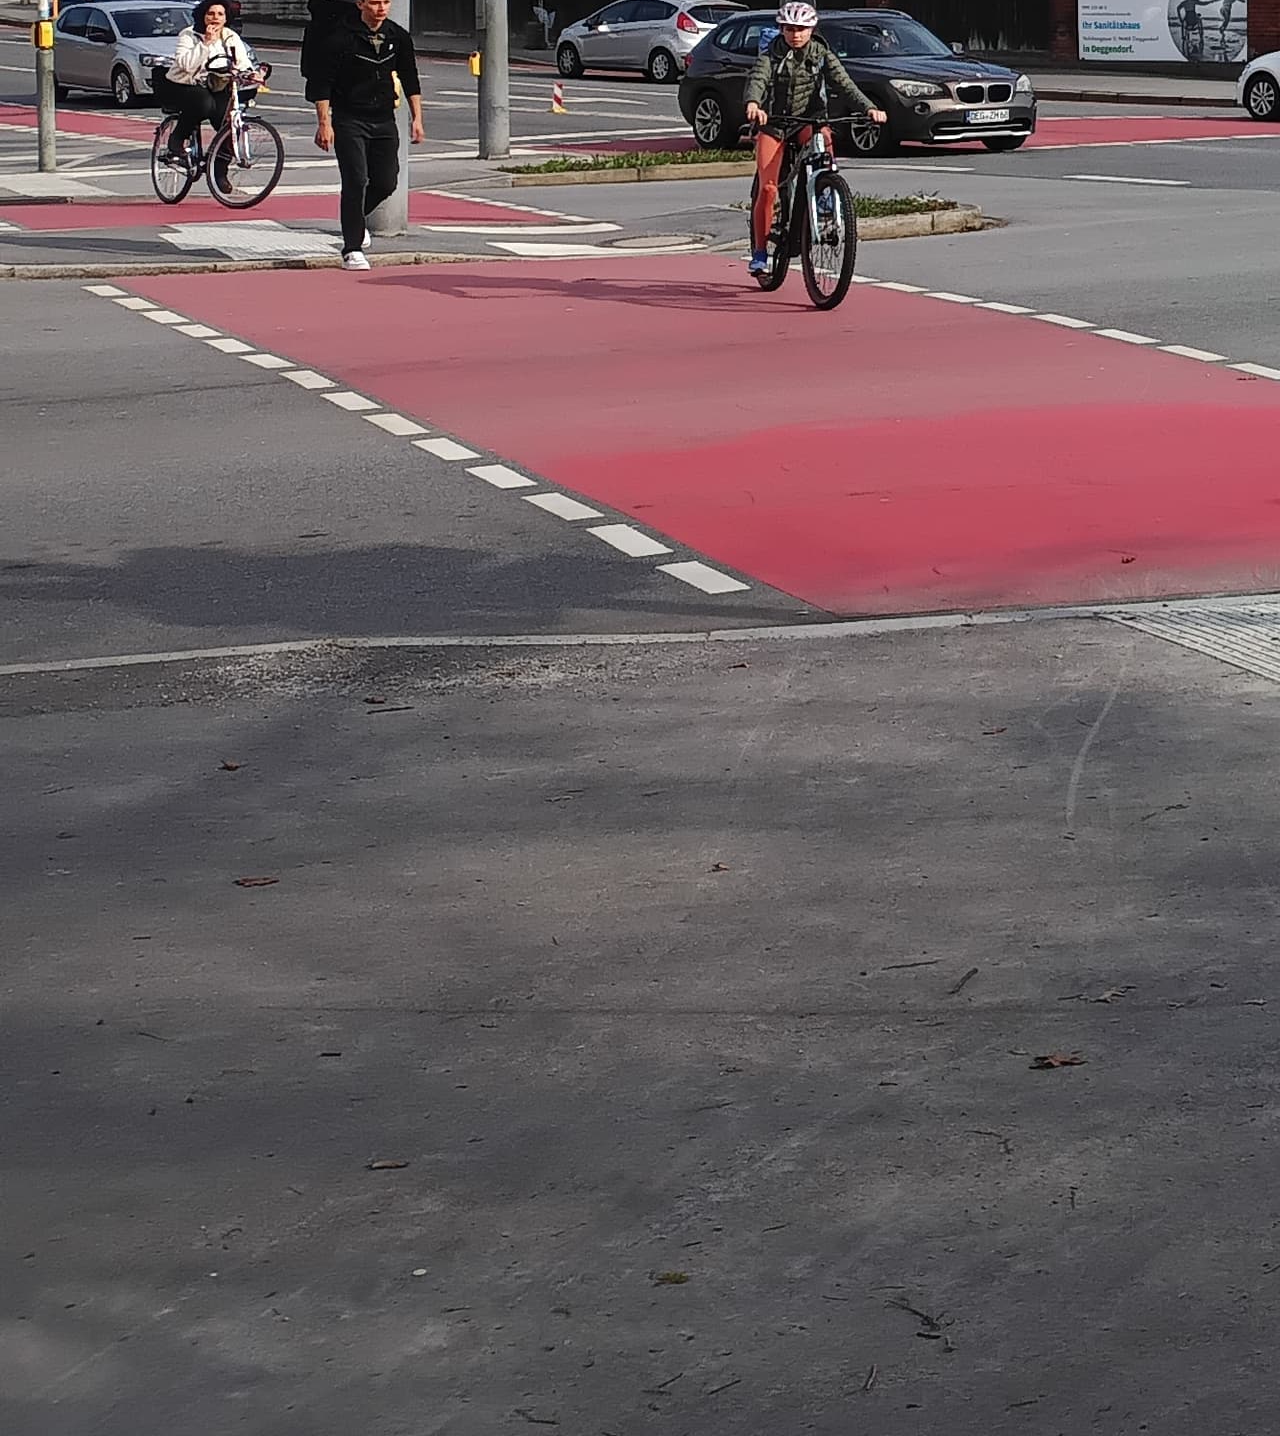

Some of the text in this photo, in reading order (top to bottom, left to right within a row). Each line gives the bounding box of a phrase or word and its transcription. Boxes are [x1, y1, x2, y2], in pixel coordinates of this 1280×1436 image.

[1082, 20, 1141, 29] Ihr Sanitätshaus
[1083, 45, 1134, 54] in Deggendorf.
